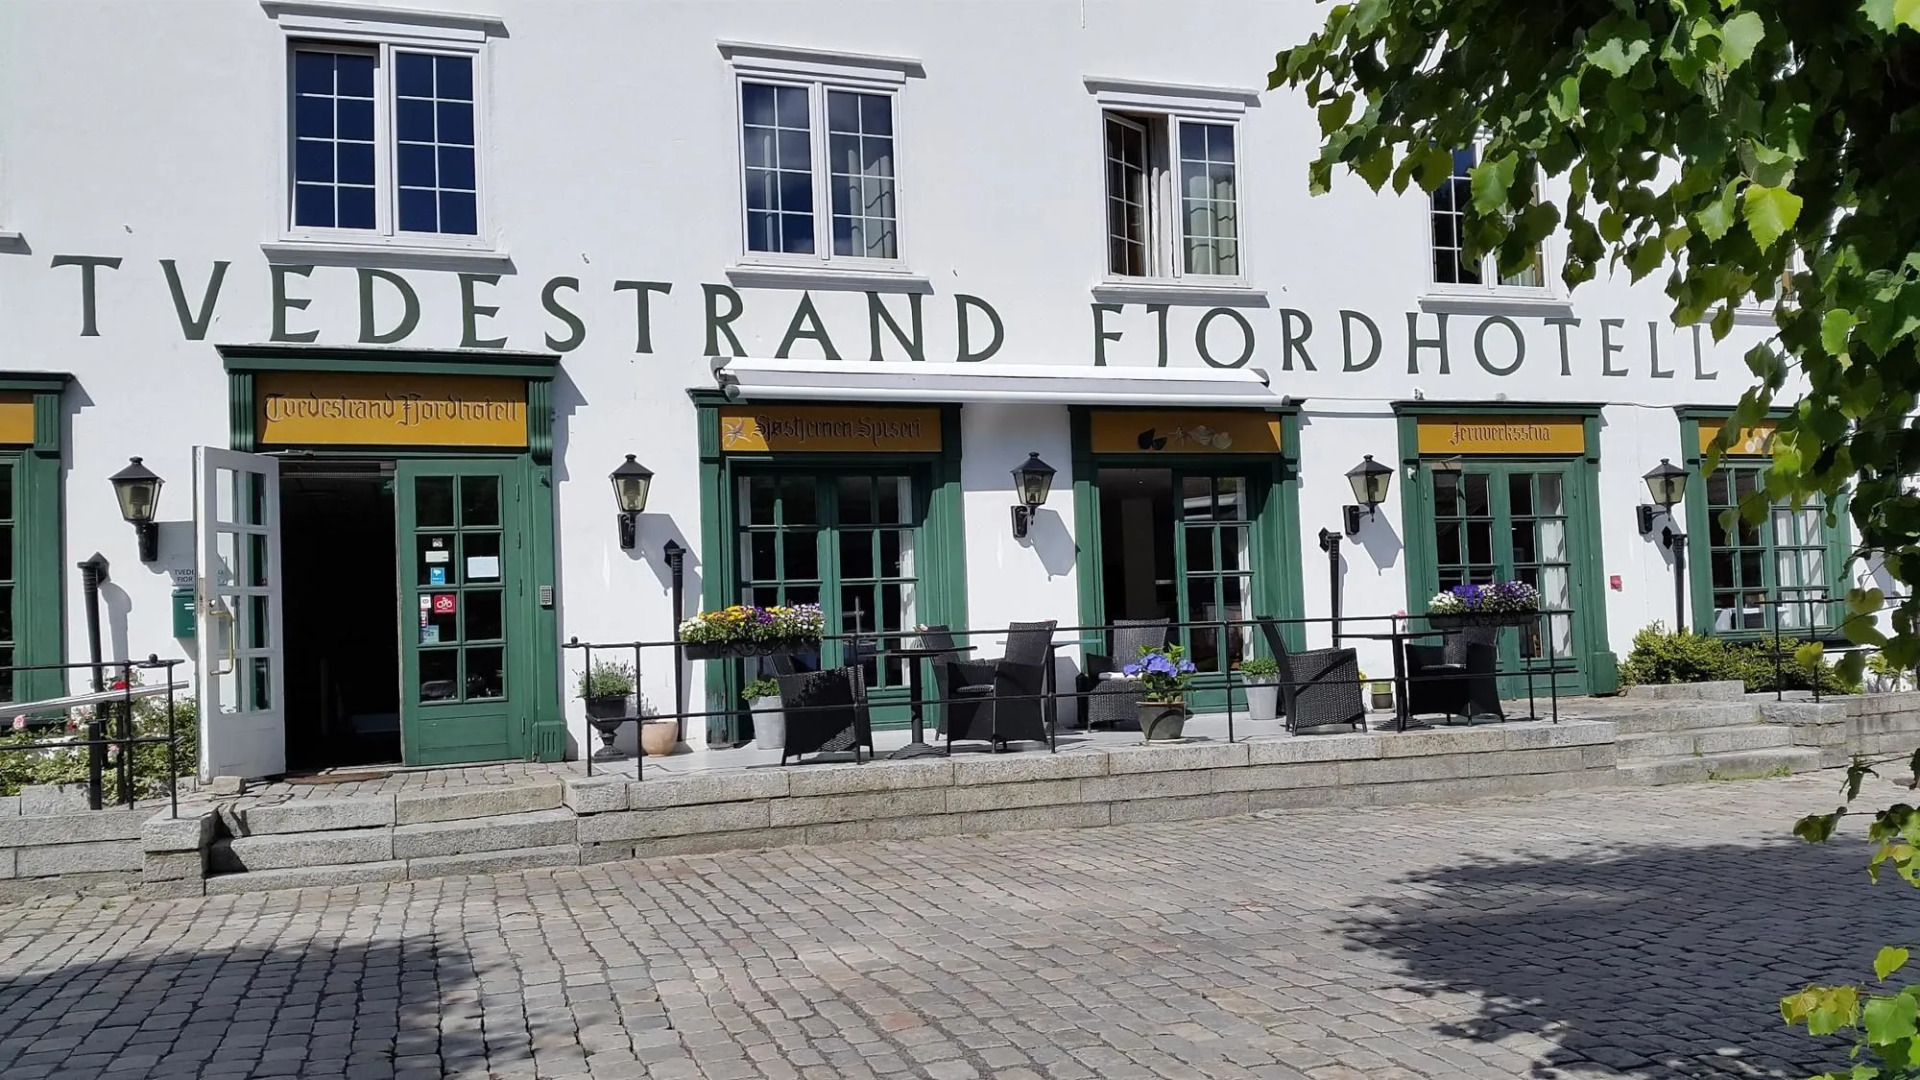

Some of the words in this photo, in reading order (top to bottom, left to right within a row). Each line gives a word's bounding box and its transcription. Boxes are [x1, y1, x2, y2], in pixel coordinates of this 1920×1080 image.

[51, 254, 1004, 362] TVEDESTRAND
[1090, 303, 1719, 380] FJORDHOTELL
[264, 392, 394, 422] Tvedestrand
[858, 417, 921, 447] Spiseri
